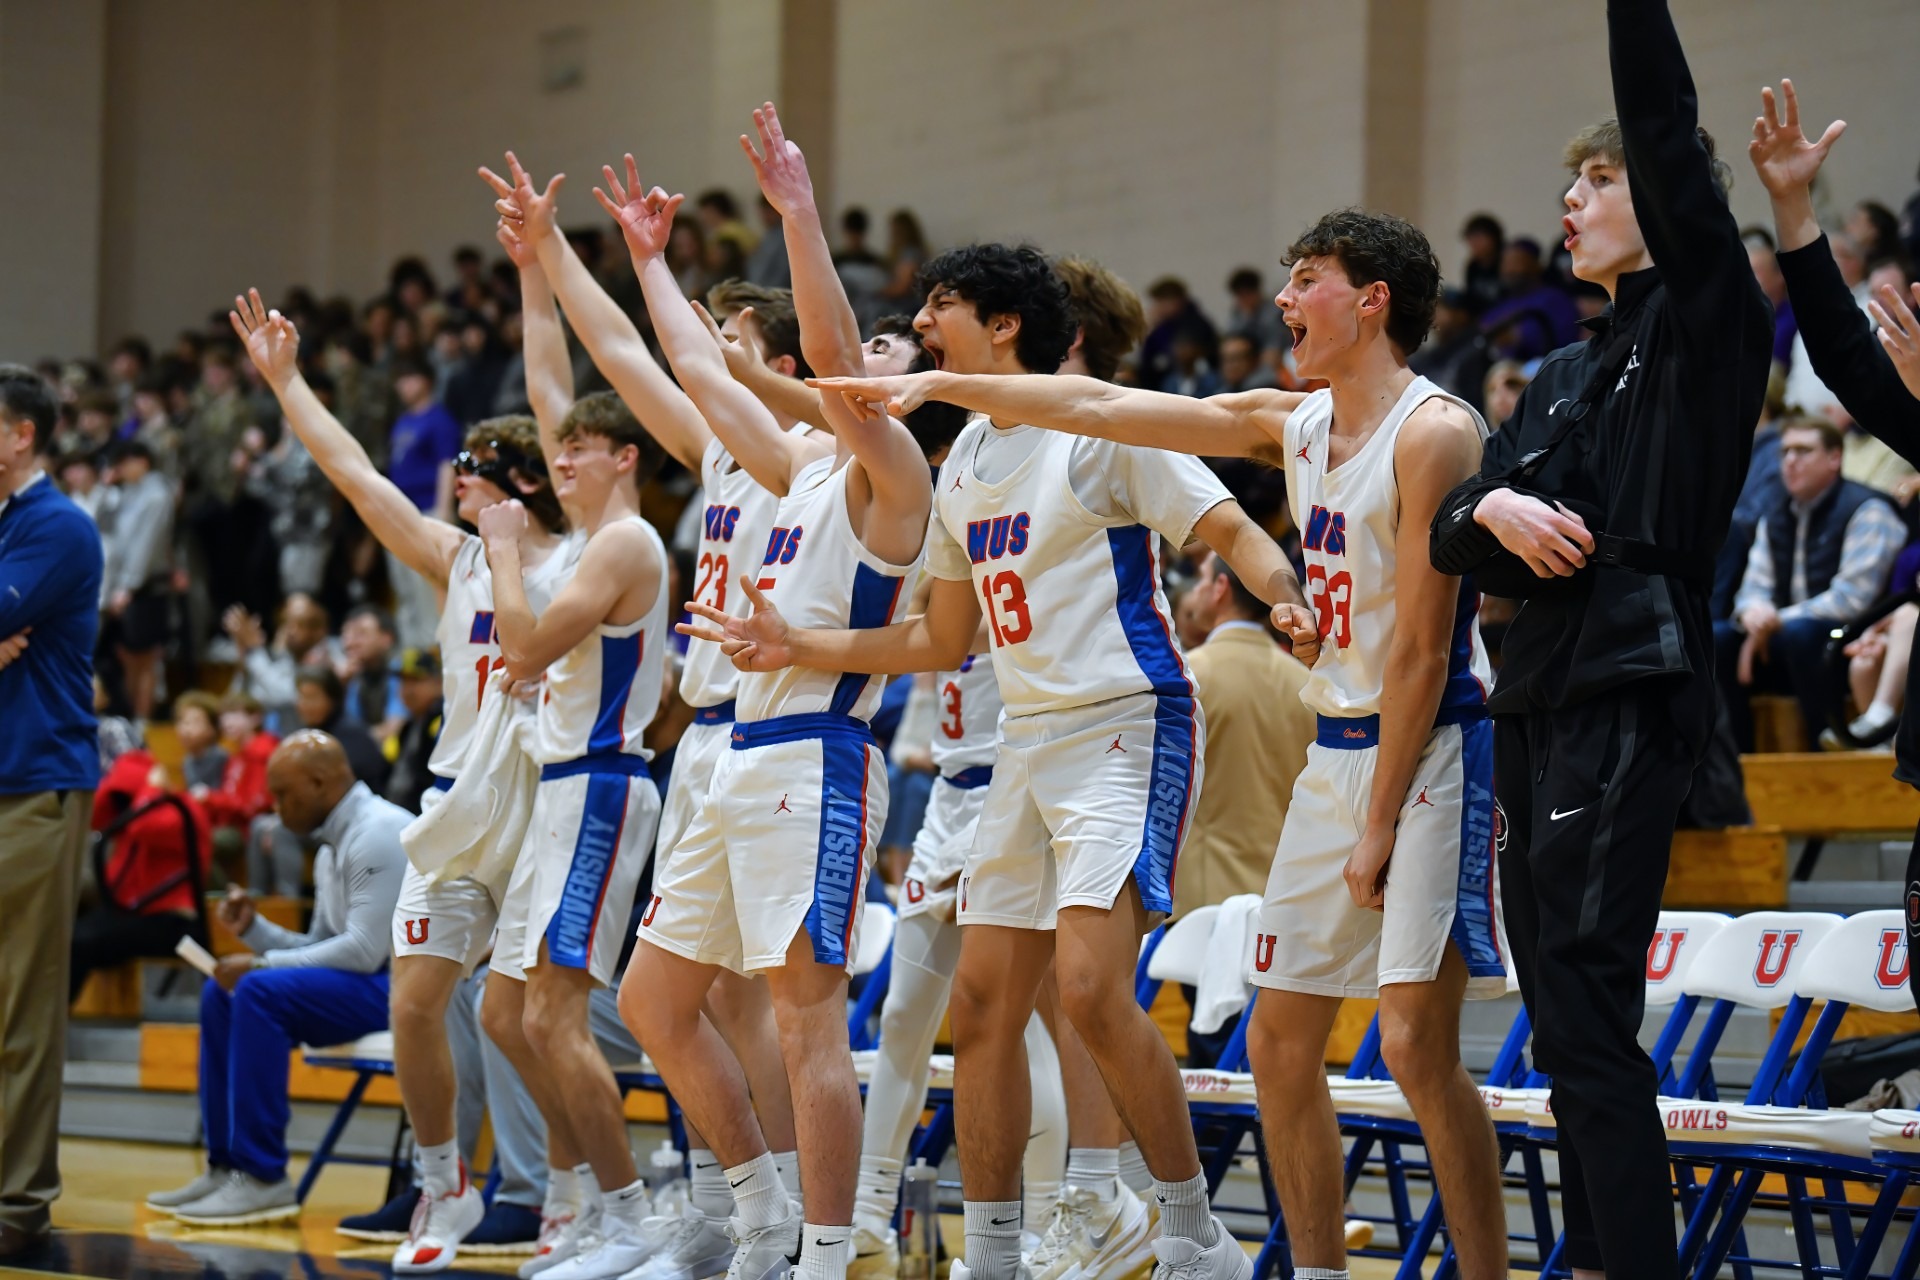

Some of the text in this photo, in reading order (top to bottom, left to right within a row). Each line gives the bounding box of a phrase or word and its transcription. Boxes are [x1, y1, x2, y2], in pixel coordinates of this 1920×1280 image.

[761, 525, 803, 570] US
[967, 511, 1031, 565] MUS
[693, 551, 729, 612] 23
[982, 570, 1032, 648] 13
[1306, 563, 1353, 649] 33
[942, 681, 964, 740] 3
[1147, 734, 1188, 899] UNIVERSITY
[557, 814, 616, 956] UNIVERSITY
[818, 786, 865, 953] UNIVERSITY
[1459, 782, 1496, 963] UNIVERSITY
[405, 918, 430, 945] U
[1255, 933, 1277, 973] U
[1646, 928, 1688, 984] U
[1752, 929, 1803, 988] U
[1667, 1109, 1729, 1130] OWLS
